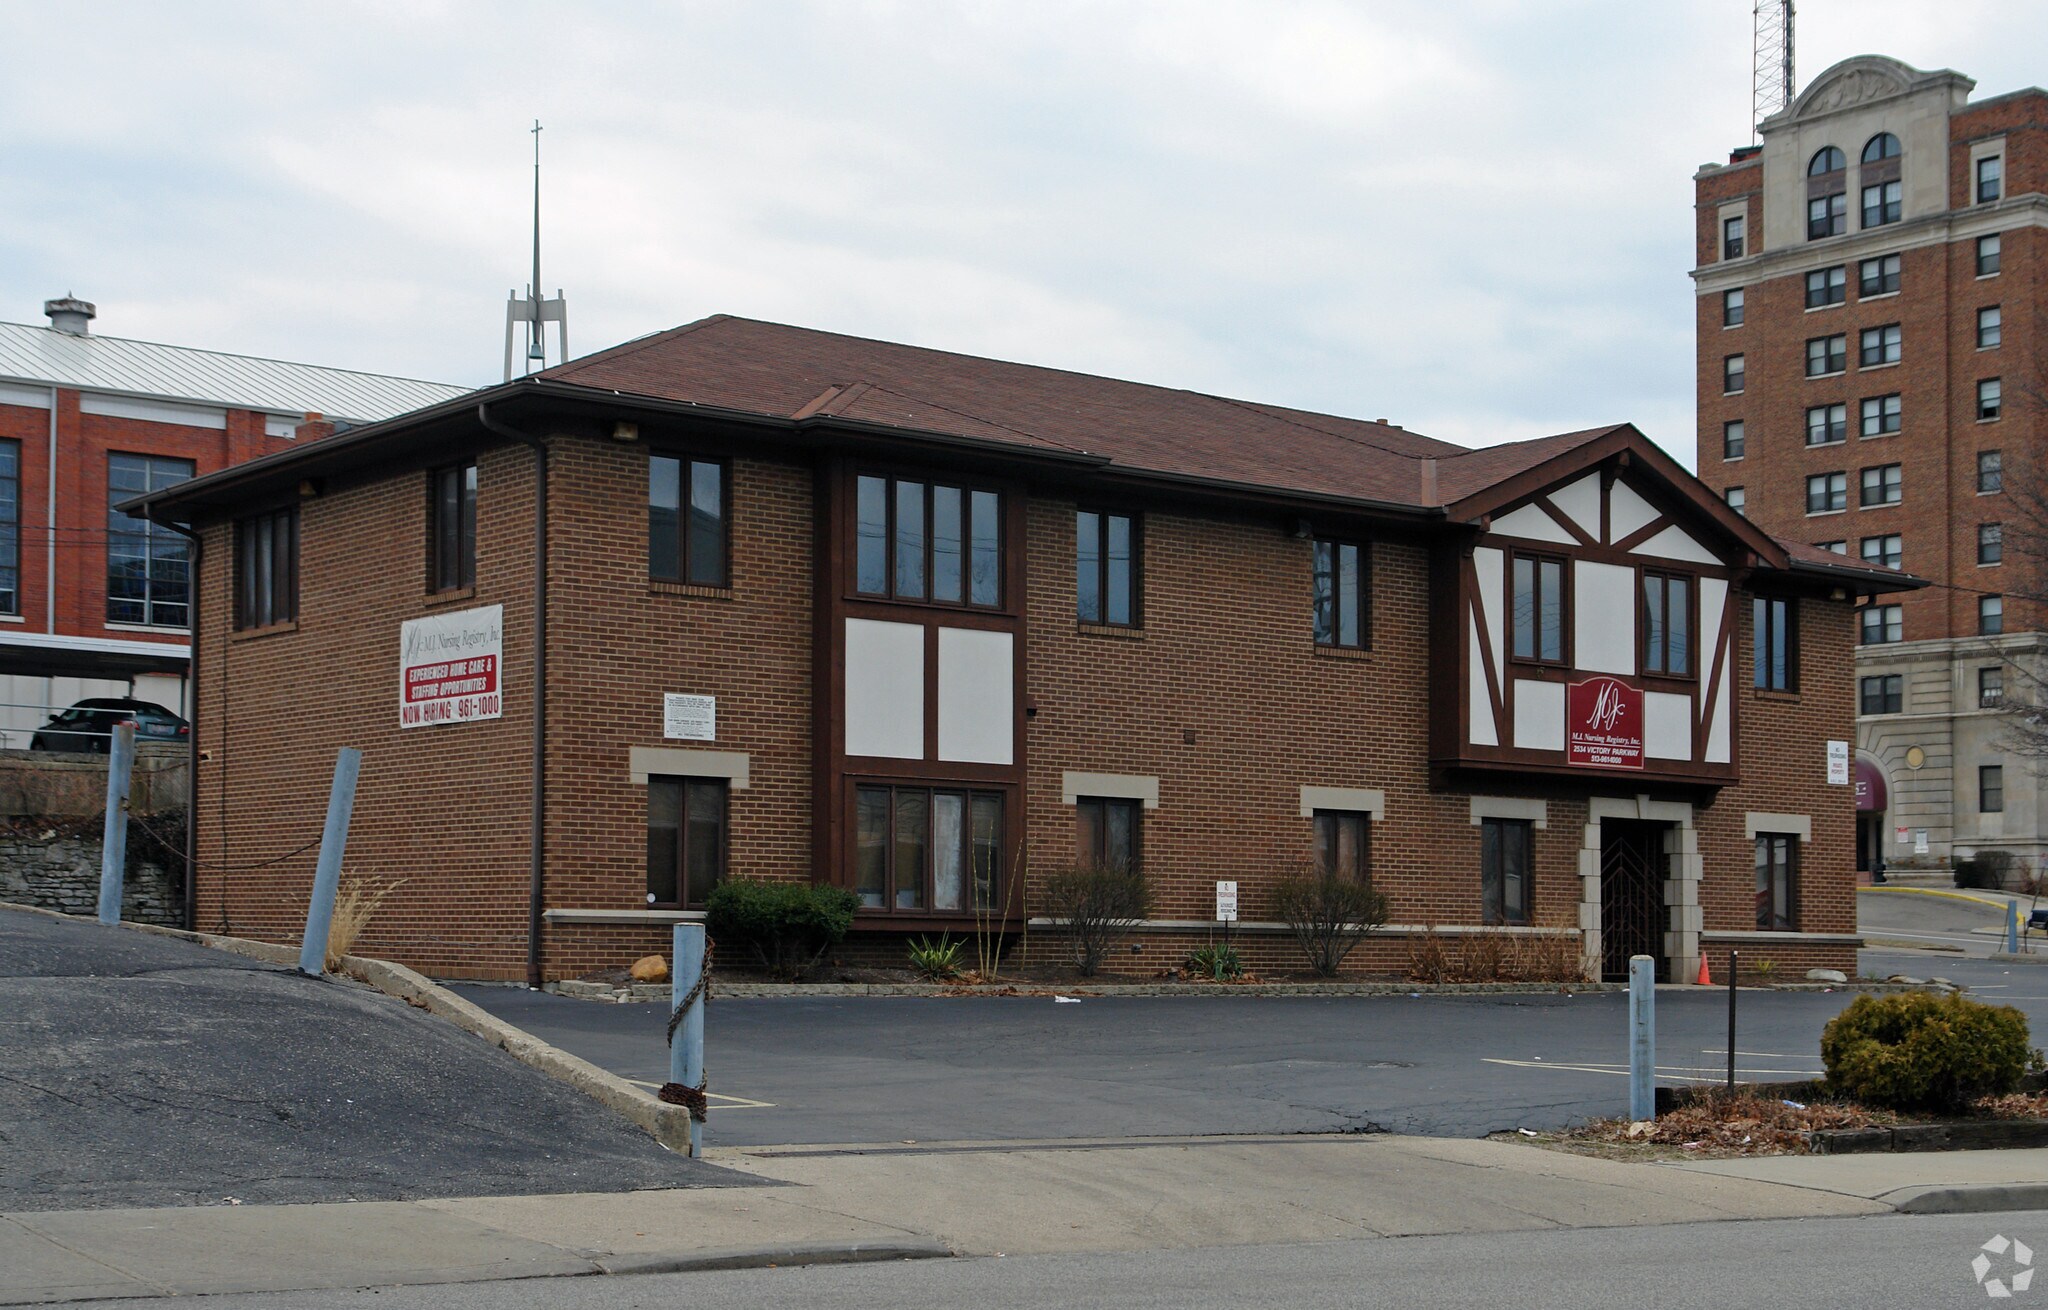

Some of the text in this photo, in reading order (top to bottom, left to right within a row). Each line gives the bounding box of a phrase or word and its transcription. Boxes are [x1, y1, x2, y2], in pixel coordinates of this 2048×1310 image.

[438, 632, 460, 650] Nursing
[409, 658, 492, 682] EXPERIENCED HOME CARE &
[412, 677, 486, 699] STAFFING OPPORTUNITIES
[403, 695, 499, 724] NOW HIRING 961-1000
[1584, 733, 1605, 743] Nursing
[1573, 745, 1639, 757] 2534 VICTORY PARKWAY
